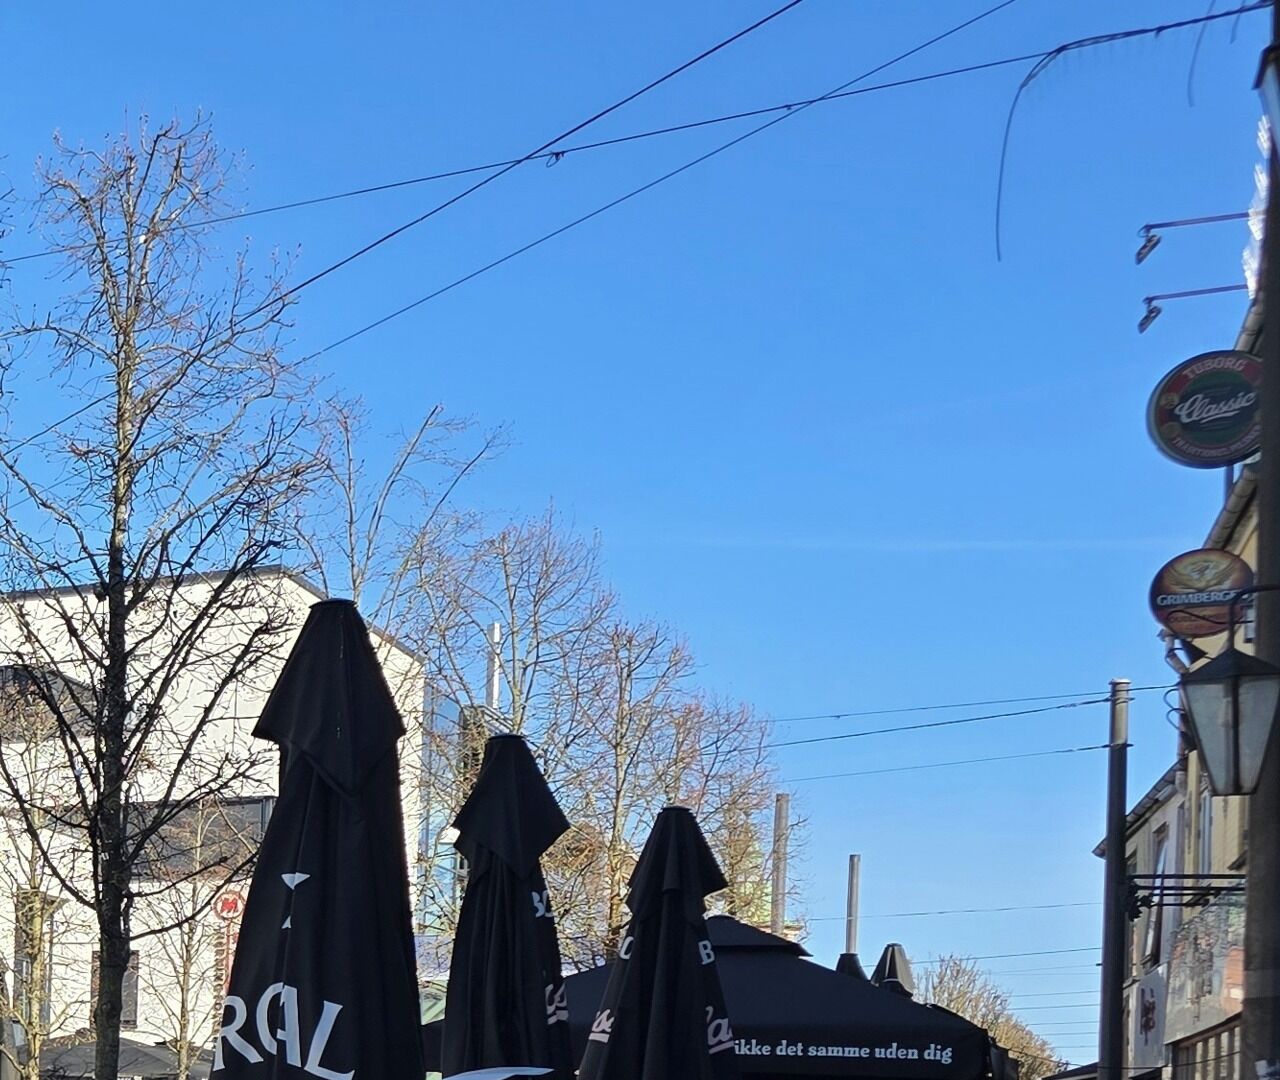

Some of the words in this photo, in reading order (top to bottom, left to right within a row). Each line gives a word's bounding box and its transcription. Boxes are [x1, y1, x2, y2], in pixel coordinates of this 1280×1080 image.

[1181, 356, 1247, 380] TUBORG
[1174, 391, 1257, 423] Classic
[733, 1039, 772, 1056] ikke
[775, 1039, 804, 1057] det
[807, 1045, 871, 1059] samme
[874, 1042, 919, 1060] uden
[923, 1043, 953, 1065] dig
